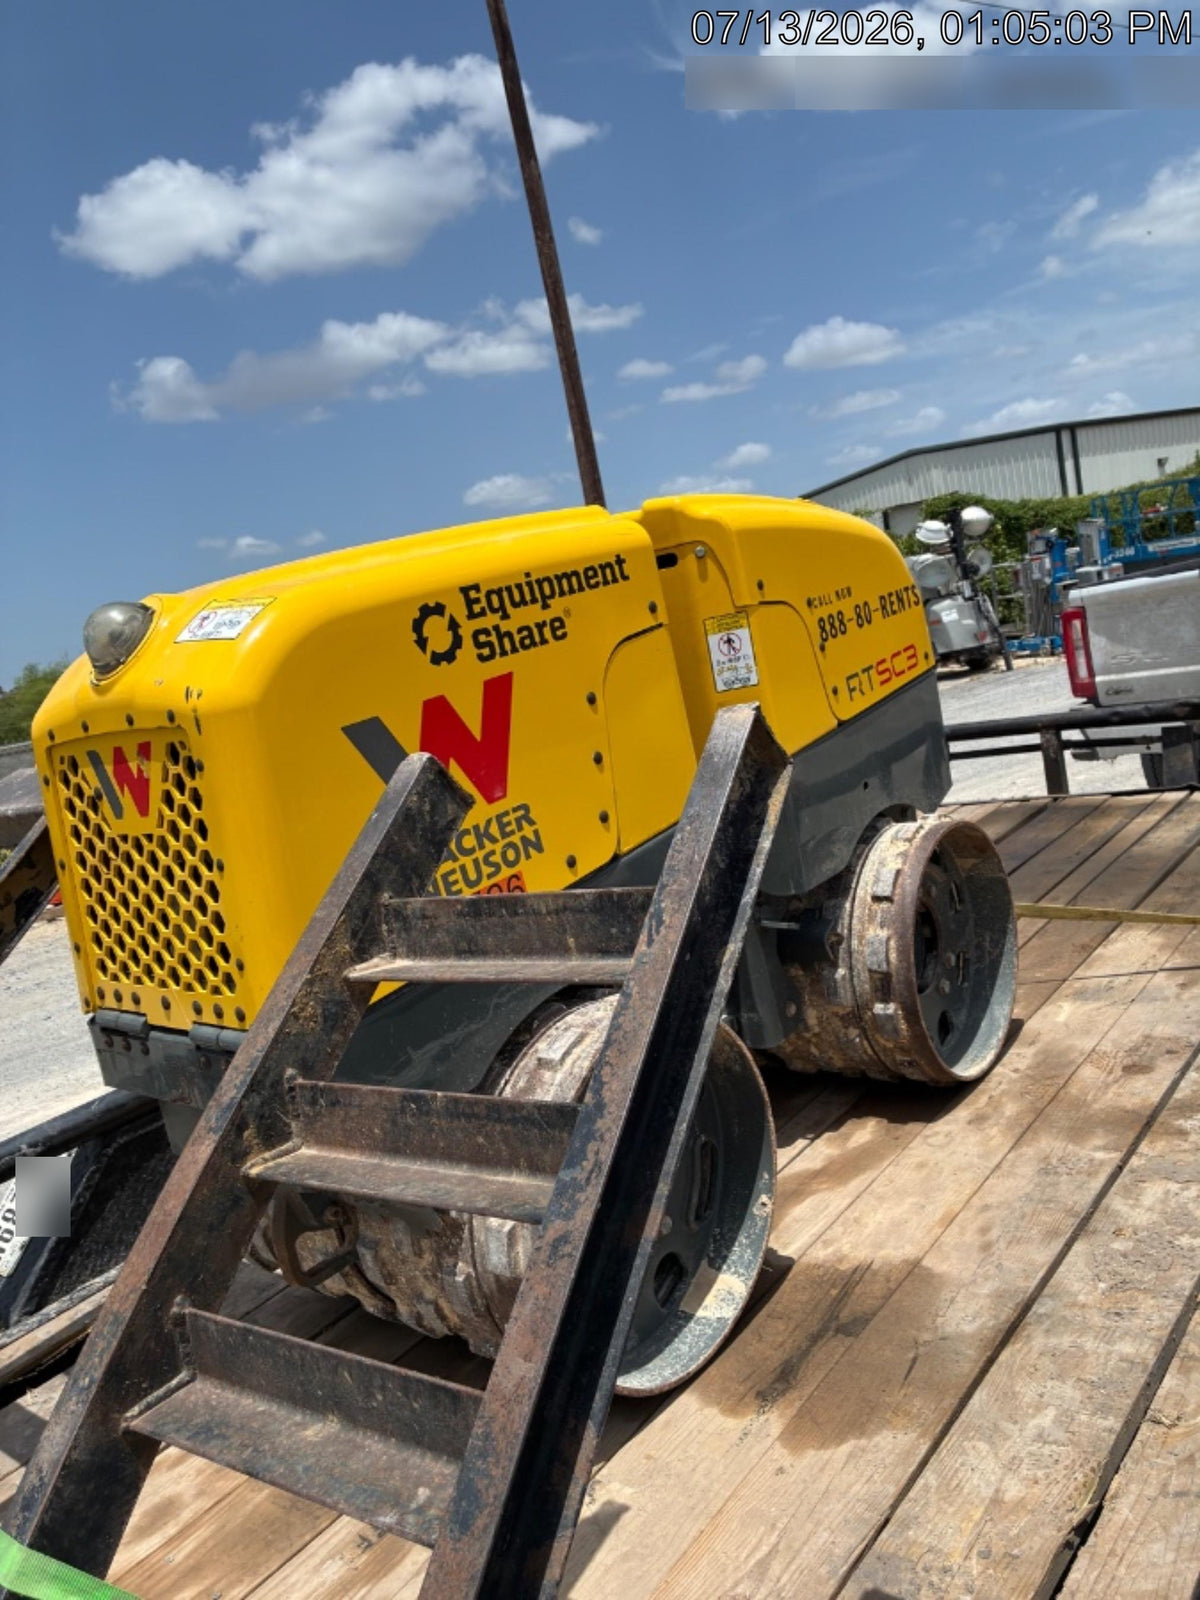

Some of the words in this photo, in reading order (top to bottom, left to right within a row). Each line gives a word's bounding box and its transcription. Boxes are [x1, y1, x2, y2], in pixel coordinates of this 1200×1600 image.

[458, 553, 630, 621] Equipment
[817, 584, 920, 643] 888-80-RENTS
[441, 802, 537, 863] CKER
